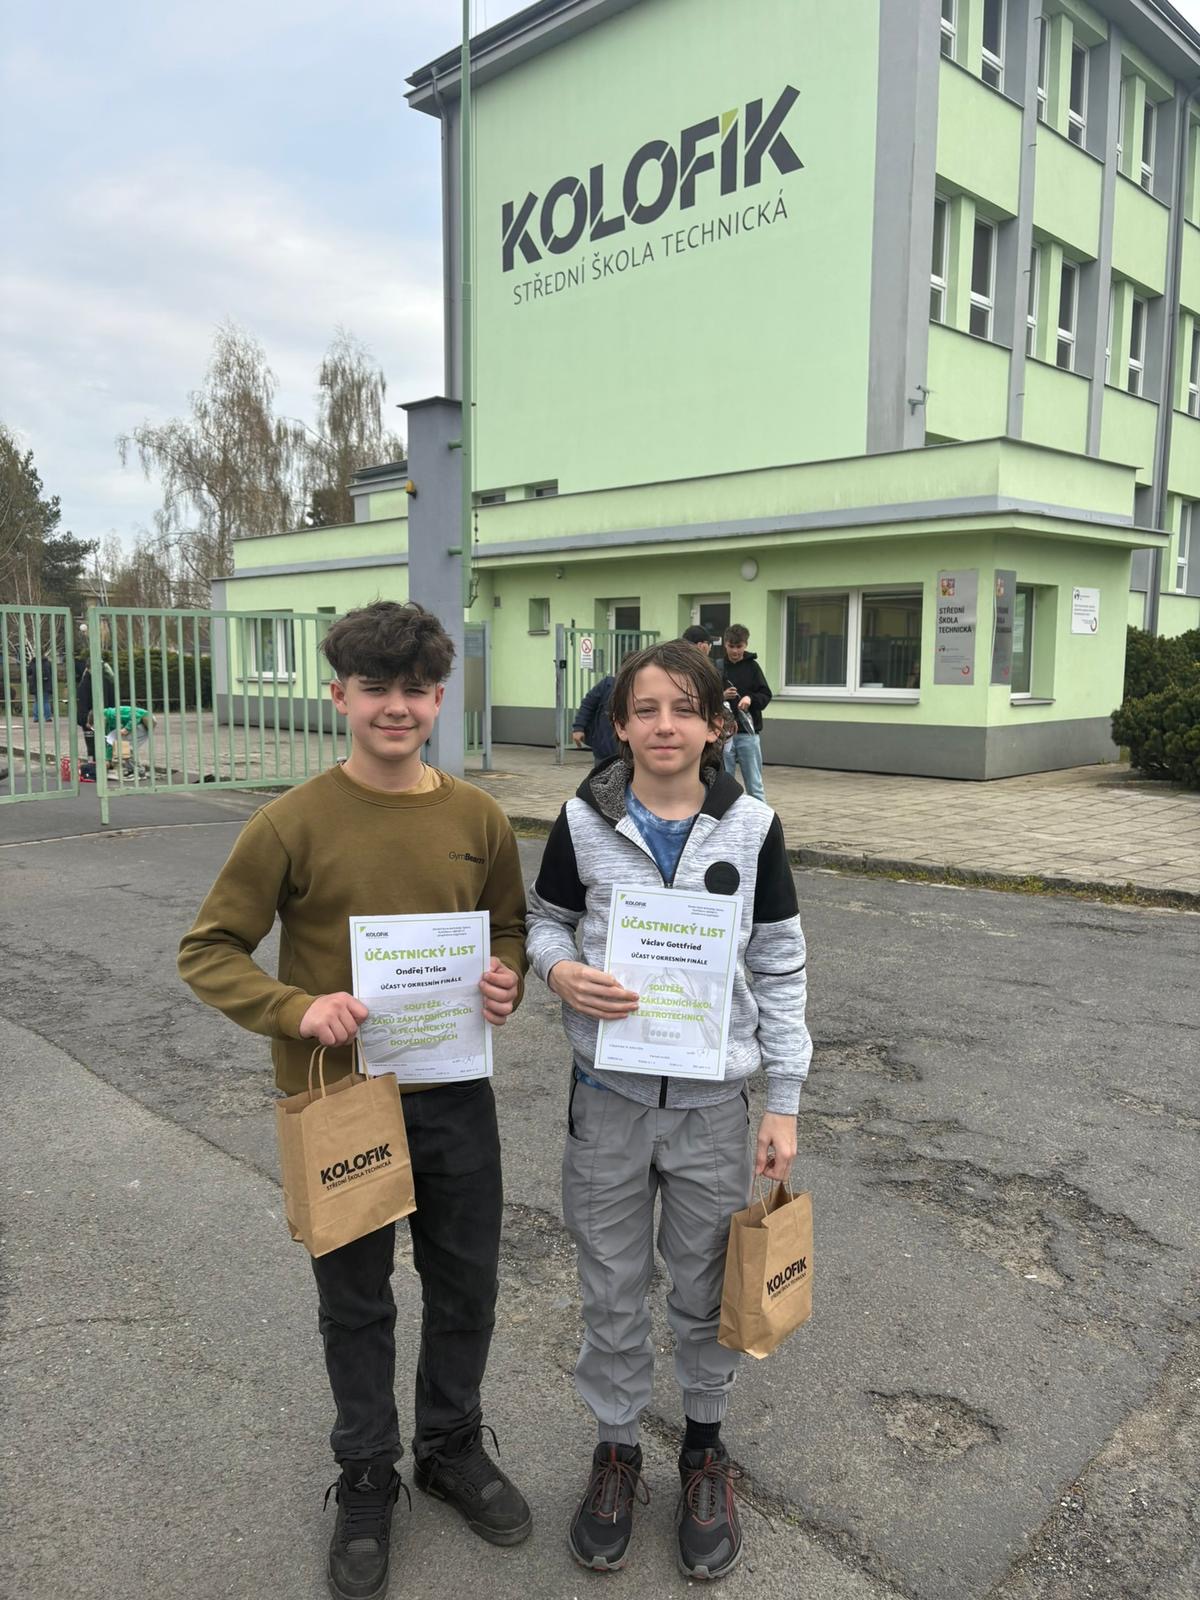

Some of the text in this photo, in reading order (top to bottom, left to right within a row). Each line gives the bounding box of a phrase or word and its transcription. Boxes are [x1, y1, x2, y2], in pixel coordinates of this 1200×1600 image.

[513, 189, 788, 305] STŘEDNÍ ŠKOLA TECHNICKÁ
[939, 606, 965, 614] STŘEDNÍ
[938, 616, 958, 624] ŠKOLA
[939, 625, 972, 634] TECHNICKÁ
[621, 916, 726, 938] ÚČASTNICKÝ LIST
[641, 938, 702, 950] Václav Gottfried
[365, 945, 476, 961] ÚČASTNICKÝ LIST
[656, 954, 686, 962] OKRESNÍM
[396, 966, 446, 975] Ondřej Trlica
[380, 982, 400, 990] ÚČAST
[407, 980, 440, 988] OKRESNÍM
[440, 976, 462, 984] FINÁLE
[692, 999, 712, 1009] ŠKOL
[326, 1160, 392, 1190] STŘEDNÍ ŠKOLA TECHNICKÁ
